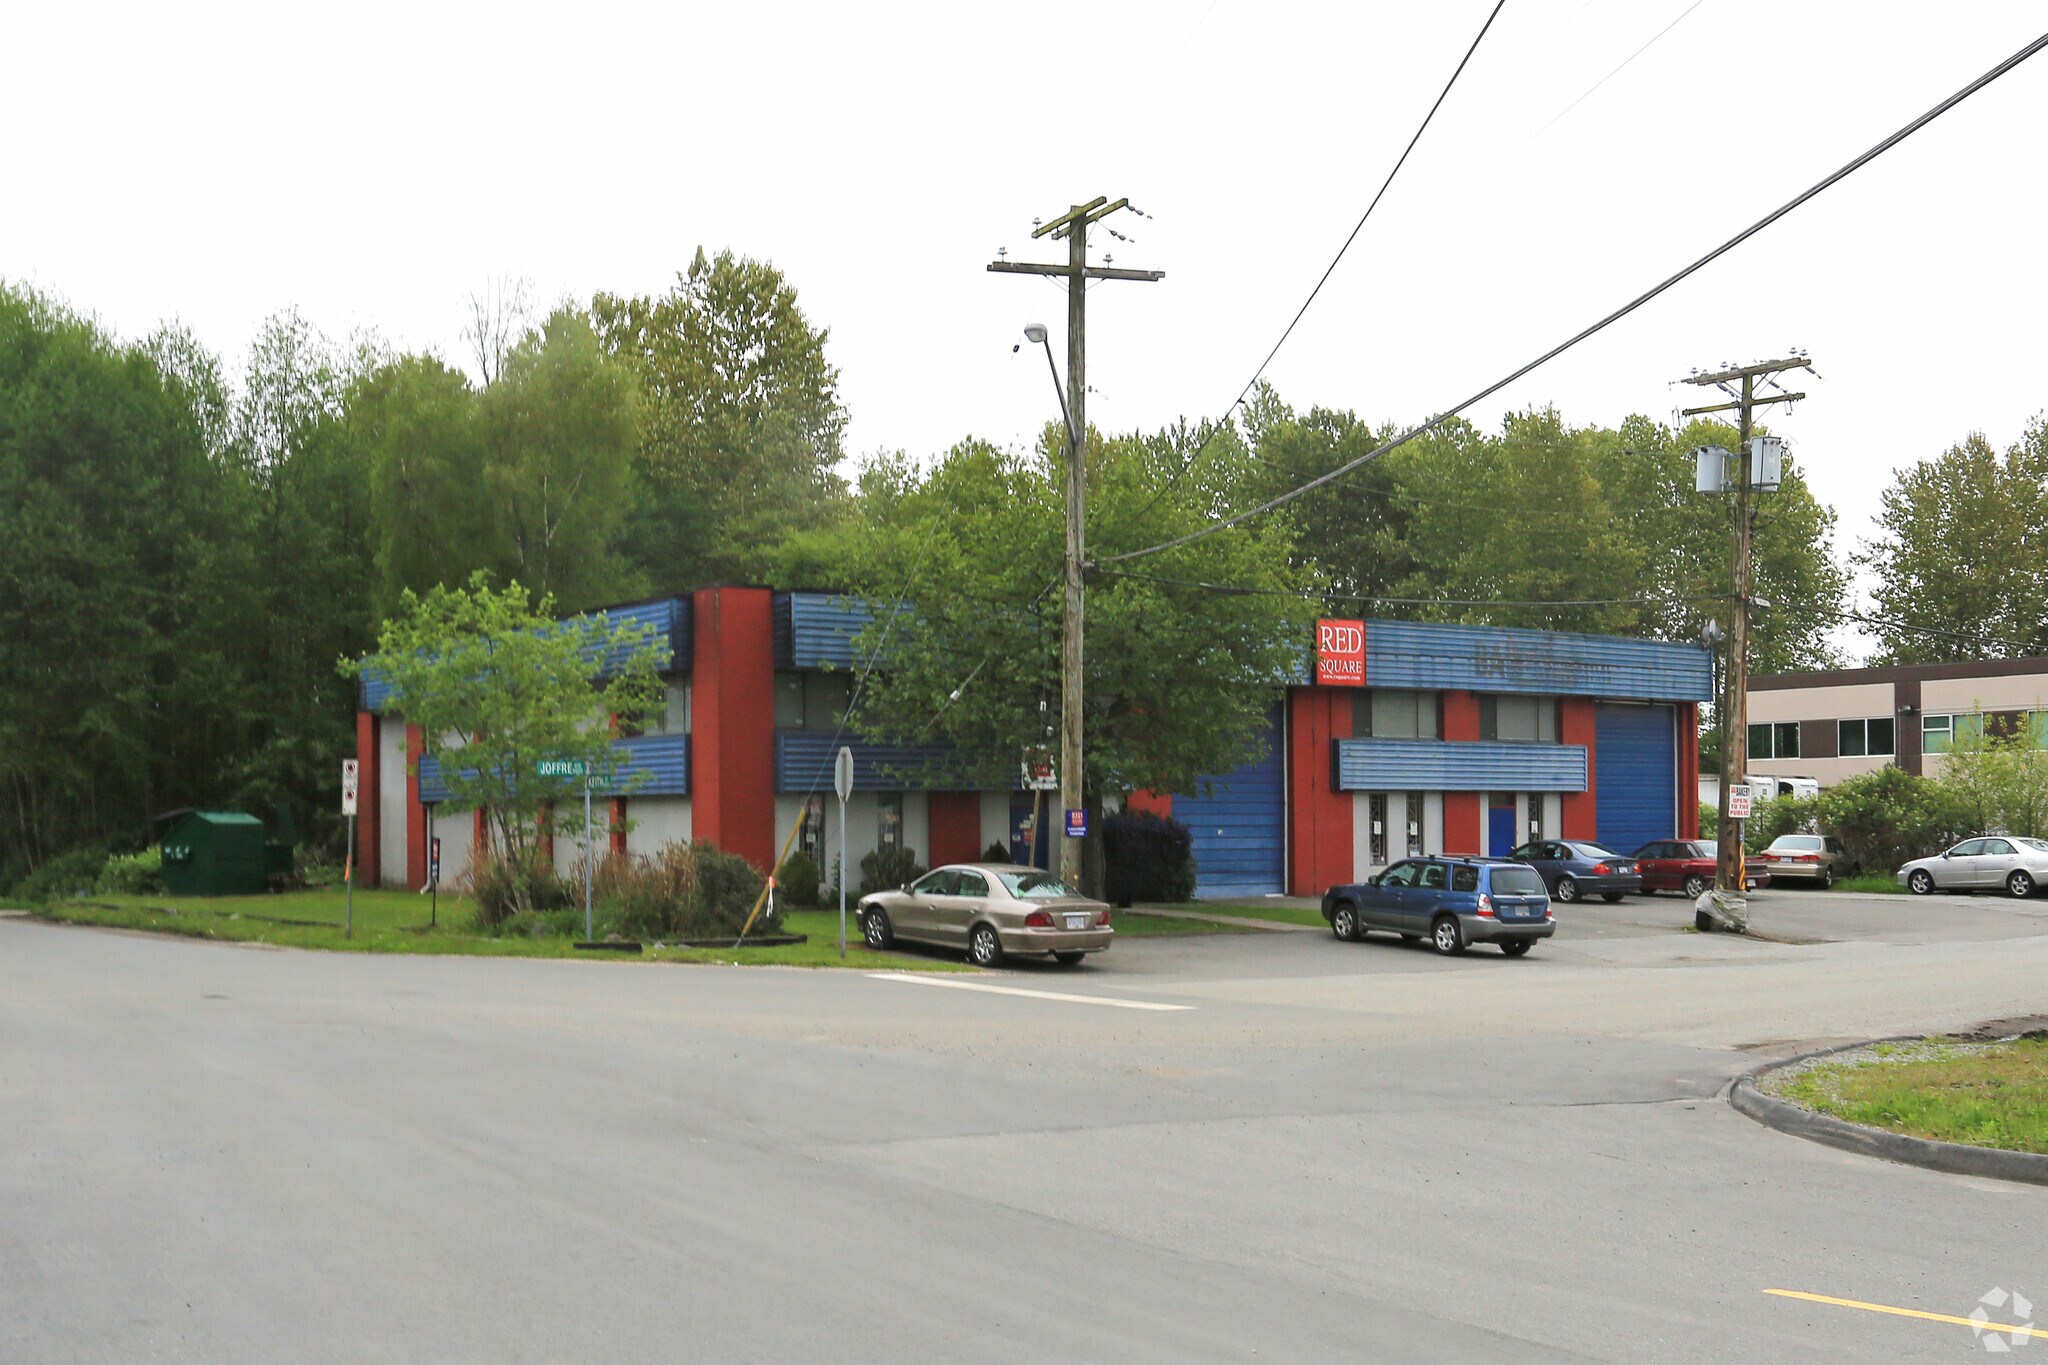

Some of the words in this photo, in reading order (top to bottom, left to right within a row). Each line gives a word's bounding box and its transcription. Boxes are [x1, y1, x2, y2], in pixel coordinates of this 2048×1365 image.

[1320, 625, 1362, 653] RED
[1320, 659, 1362, 675] SQUARE
[540, 761, 573, 775] JOFFRE
